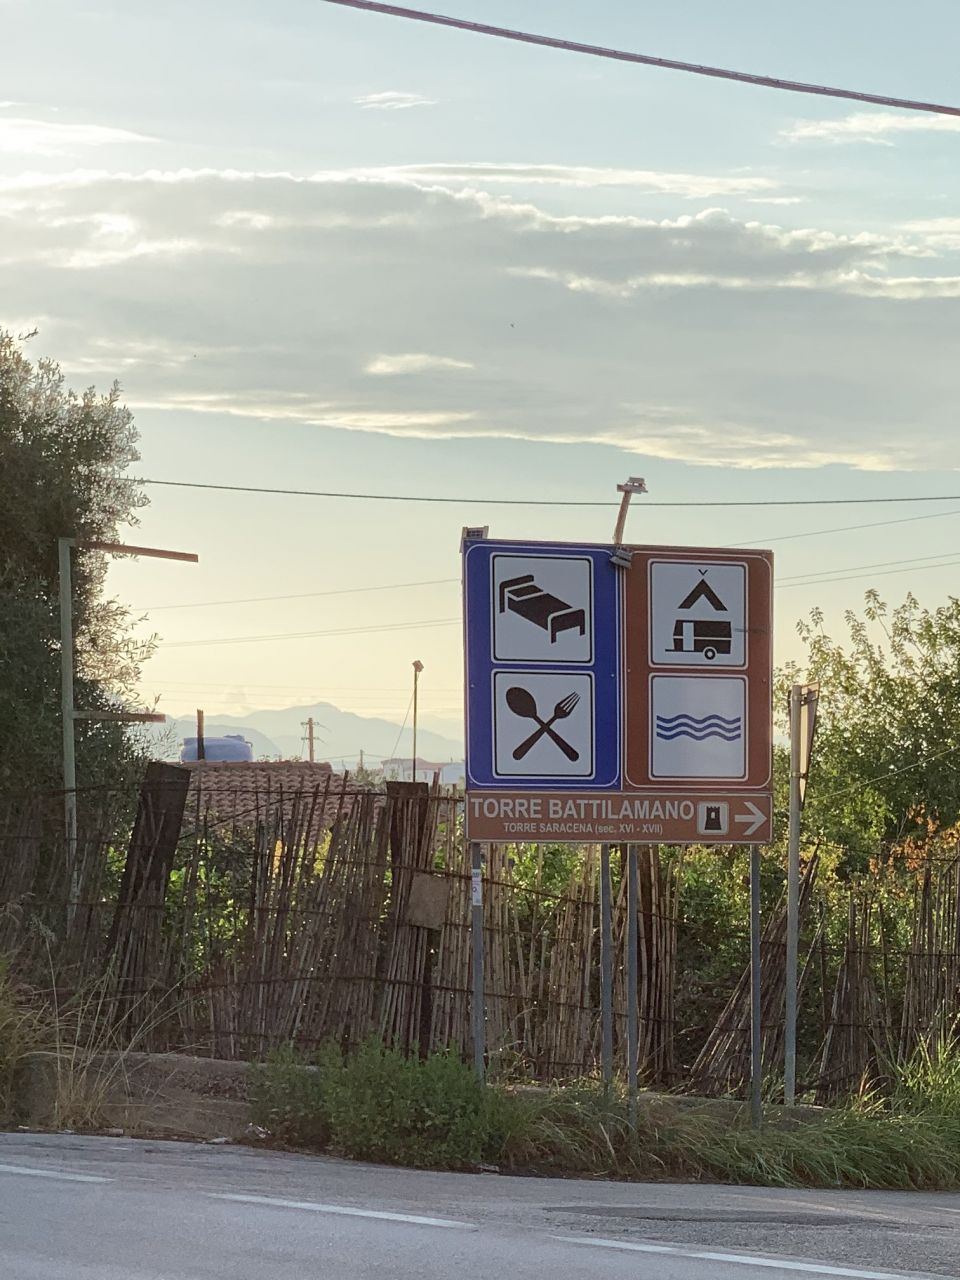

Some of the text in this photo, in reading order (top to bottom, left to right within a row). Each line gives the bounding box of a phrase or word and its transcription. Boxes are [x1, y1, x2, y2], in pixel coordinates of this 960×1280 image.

[471, 798, 695, 820] TORRE BATTILAMANO
[504, 822, 537, 833] TORRE
[539, 822, 593, 834] SARACENA
[619, 823, 634, 834] XVI
[642, 823, 663, 835] XVII)
